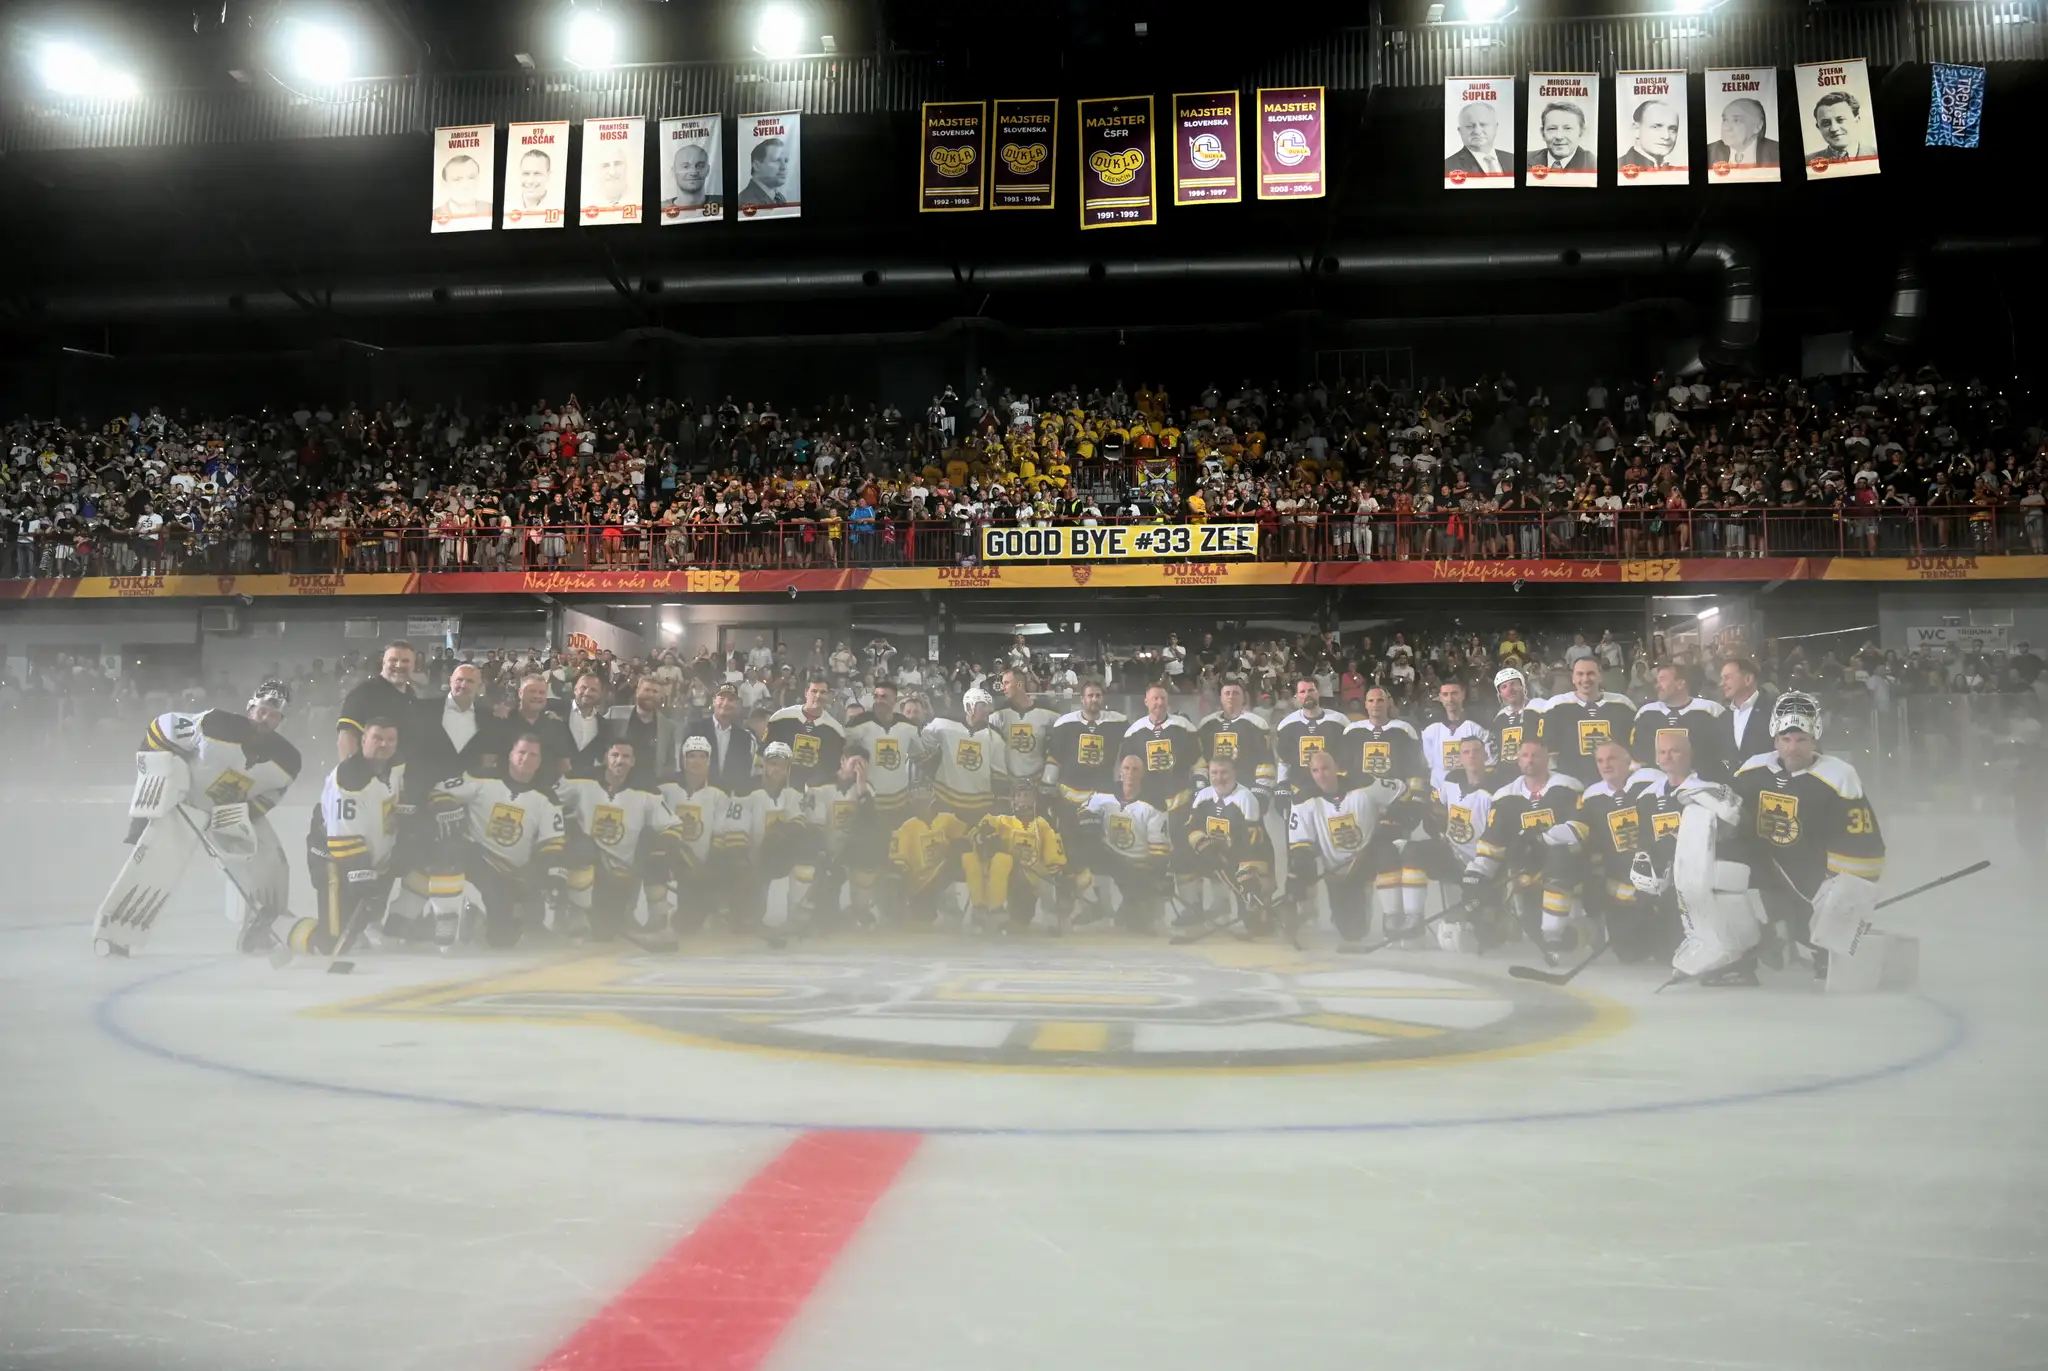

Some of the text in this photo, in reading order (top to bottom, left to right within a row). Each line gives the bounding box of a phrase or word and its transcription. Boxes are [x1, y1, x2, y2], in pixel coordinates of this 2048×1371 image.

[1818, 67, 1844, 76] ŠTEFAN
[1721, 81, 1760, 92] ZELENAY
[1817, 74, 1847, 87] ŠOLTY
[1462, 90, 1497, 101] ŠUPLER
[1539, 84, 1589, 97] ČERVENKA
[1180, 107, 1232, 118] MAJSTER
[1264, 102, 1317, 113] MAJSTER
[929, 117, 979, 127] MAJSTER
[1000, 115, 1051, 124] MAJSTER
[1086, 115, 1145, 128] MAJSTER
[1183, 119, 1228, 127] SLOVENSKA
[1267, 114, 1313, 122] SLOVENSKA
[681, 121, 700, 130] PAVOL
[752, 125, 785, 137] ŠVEHLA
[450, 131, 478, 139] JAROSLAV
[600, 131, 628, 140] HOSSA
[672, 128, 710, 140] DEMITRA
[932, 129, 975, 137] SLOVENSKA
[1103, 129, 1129, 138] ČSFR
[448, 138, 480, 149] WALTER
[933, 150, 973, 164] DUKLA
[1004, 147, 1044, 160] DUKLA
[1094, 153, 1140, 169] DUKLA
[1103, 173, 1132, 184] TRENČÍN
[545, 208, 560, 223] 10
[622, 204, 637, 218] 21
[702, 203, 719, 217] 38
[1097, 211, 1114, 219] 1991
[1120, 210, 1139, 218] 1992
[986, 530, 1061, 556] GOOD
[1071, 529, 1127, 555] BYE
[1135, 527, 1191, 553] #33
[1906, 555, 1979, 571] DUKLA
[937, 565, 1001, 579] DUKLA
[1162, 563, 1229, 577] DUKLA
[1433, 559, 1681, 582] Najlepšia u nás od 1962
[109, 576, 164, 589] DUKLA
[288, 574, 346, 587] DUKLA
[523, 571, 740, 593] Najlepšia u nás od 1962
[949, 577, 990, 587] TRENČÍN
[1174, 575, 1218, 585] TRENČÍN
[1918, 628, 1947, 640] WC
[174, 717, 196, 739] 41
[336, 797, 357, 821] 16
[1289, 812, 1299, 831] 5
